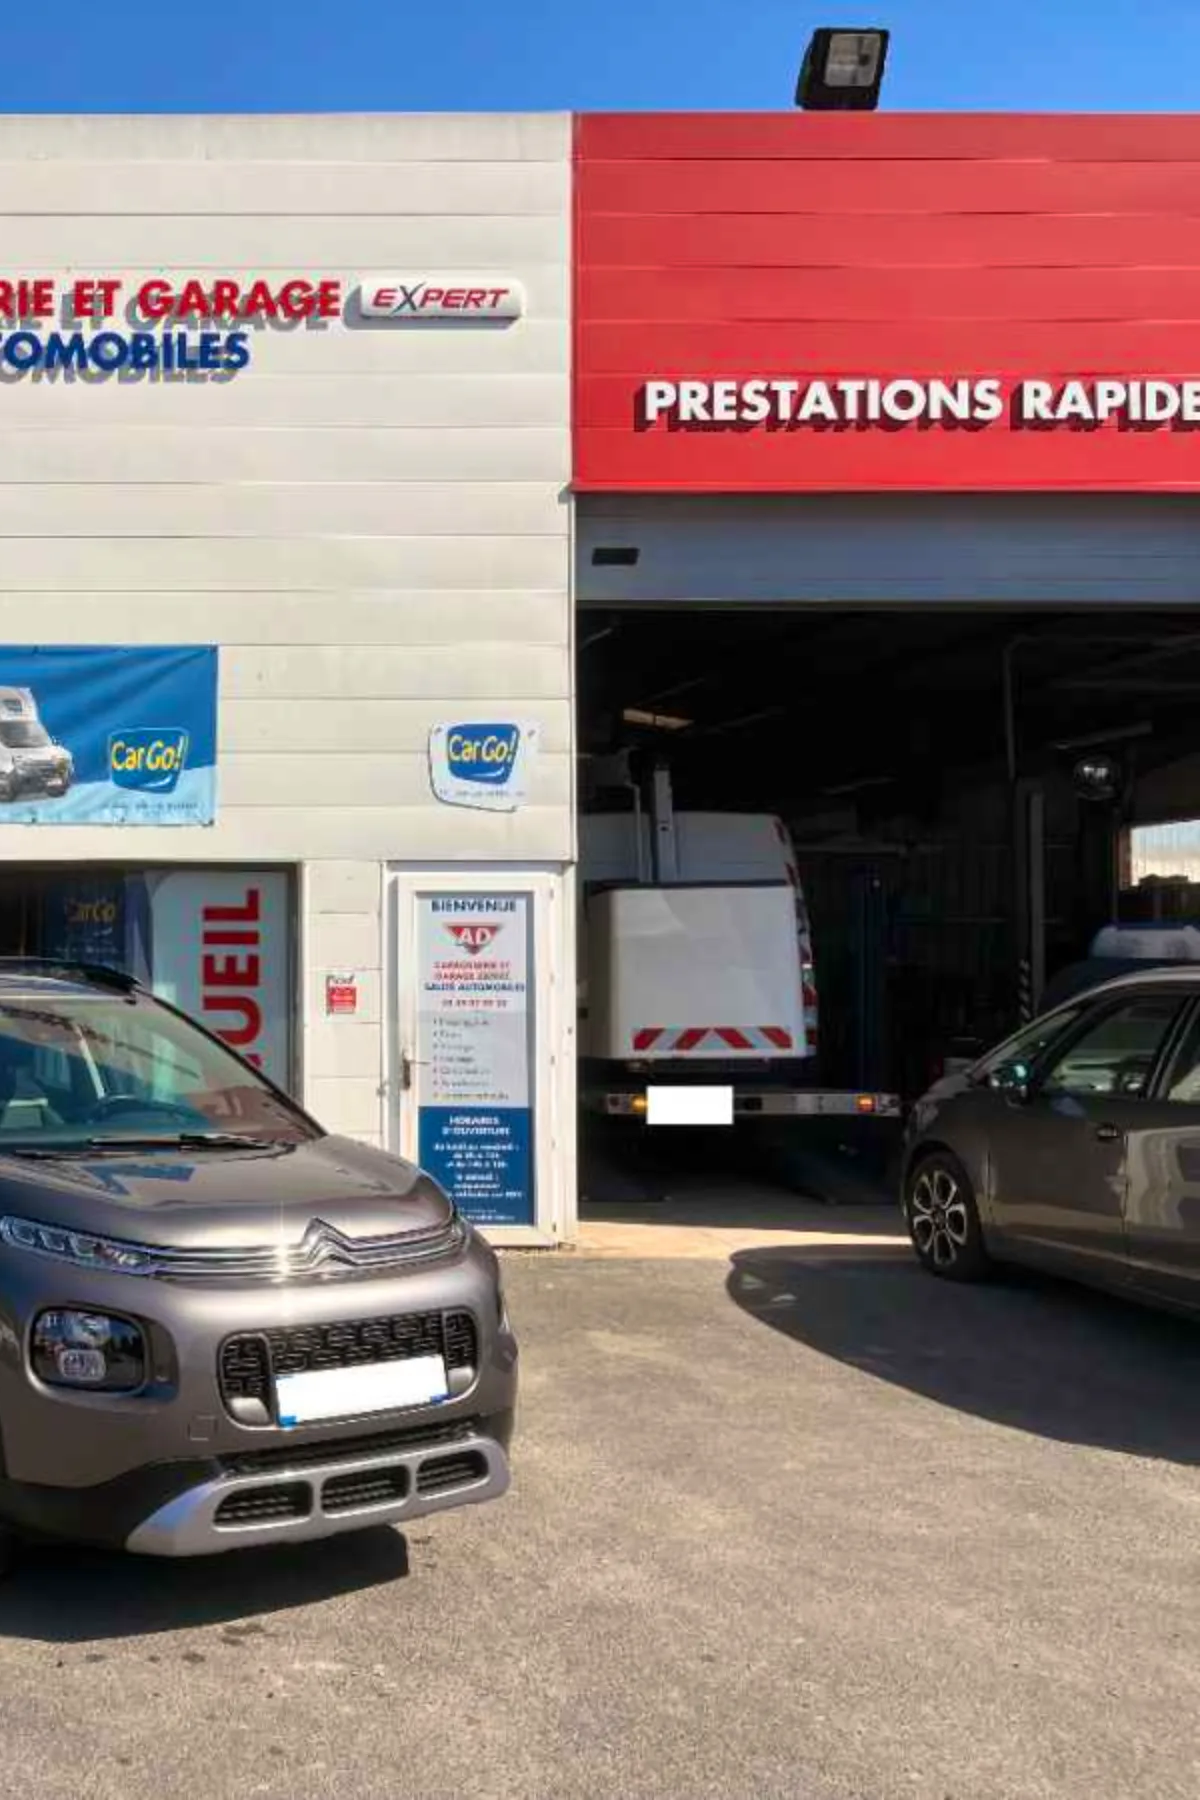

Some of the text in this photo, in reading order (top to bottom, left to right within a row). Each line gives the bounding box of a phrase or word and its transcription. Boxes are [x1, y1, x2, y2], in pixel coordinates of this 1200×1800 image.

[72, 279, 121, 319] ET
[136, 278, 341, 320] GARAGE
[373, 283, 509, 315] EXPERT
[644, 379, 1200, 421] PRESTATIONS RAPIDE
[431, 900, 516, 912] BIENVENUE
[459, 927, 492, 945] AD
[202, 889, 263, 1069] UEIL
